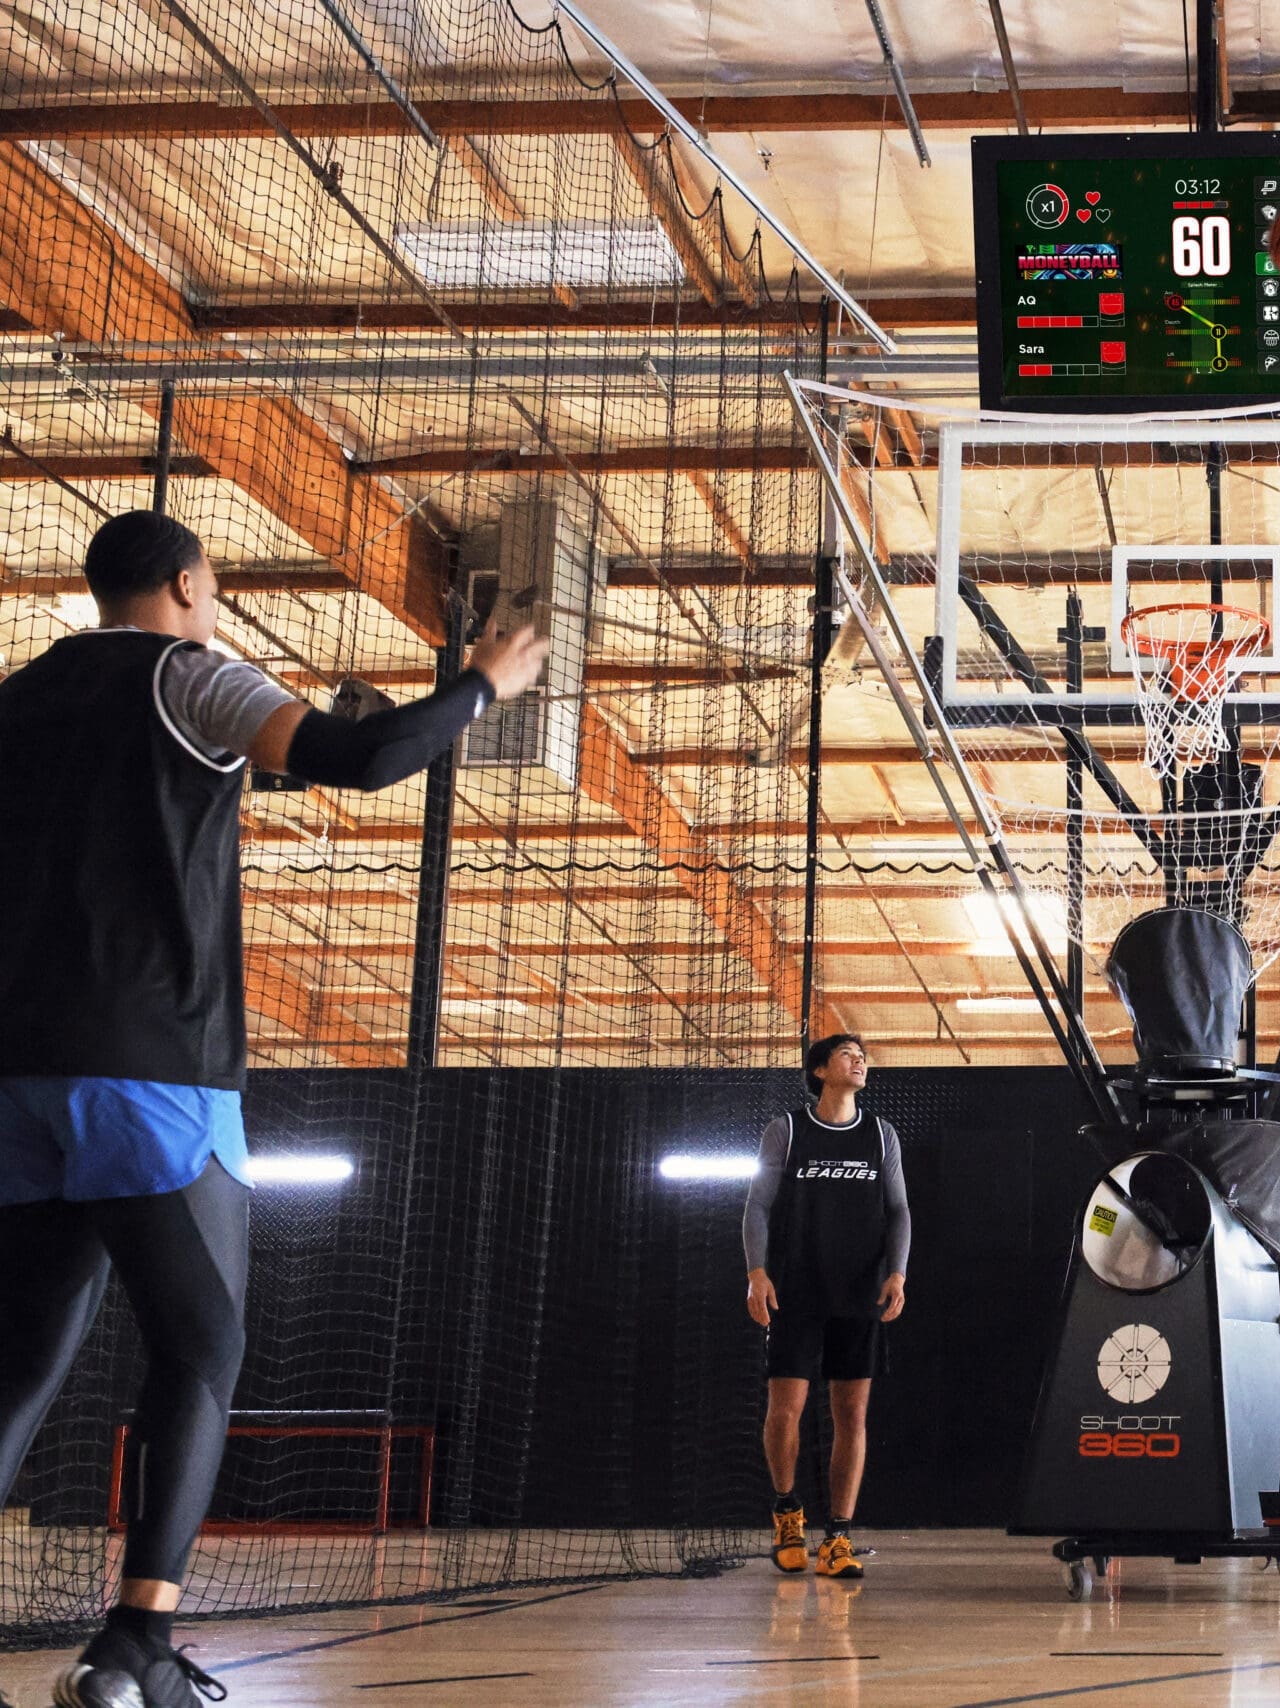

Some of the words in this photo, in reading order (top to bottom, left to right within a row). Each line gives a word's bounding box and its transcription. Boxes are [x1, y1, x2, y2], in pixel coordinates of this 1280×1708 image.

[1174, 178, 1221, 195] 03:12
[1041, 200, 1055, 213] x1
[1171, 215, 1231, 277] 60
[1018, 255, 1120, 269] MONEYBALL
[1017, 295, 1037, 306] AQ
[1019, 344, 1045, 354] Sara
[796, 1167, 878, 1180] LEAGUES
[1080, 1415, 1181, 1430] SHOOT
[1079, 1432, 1181, 1457] 360
